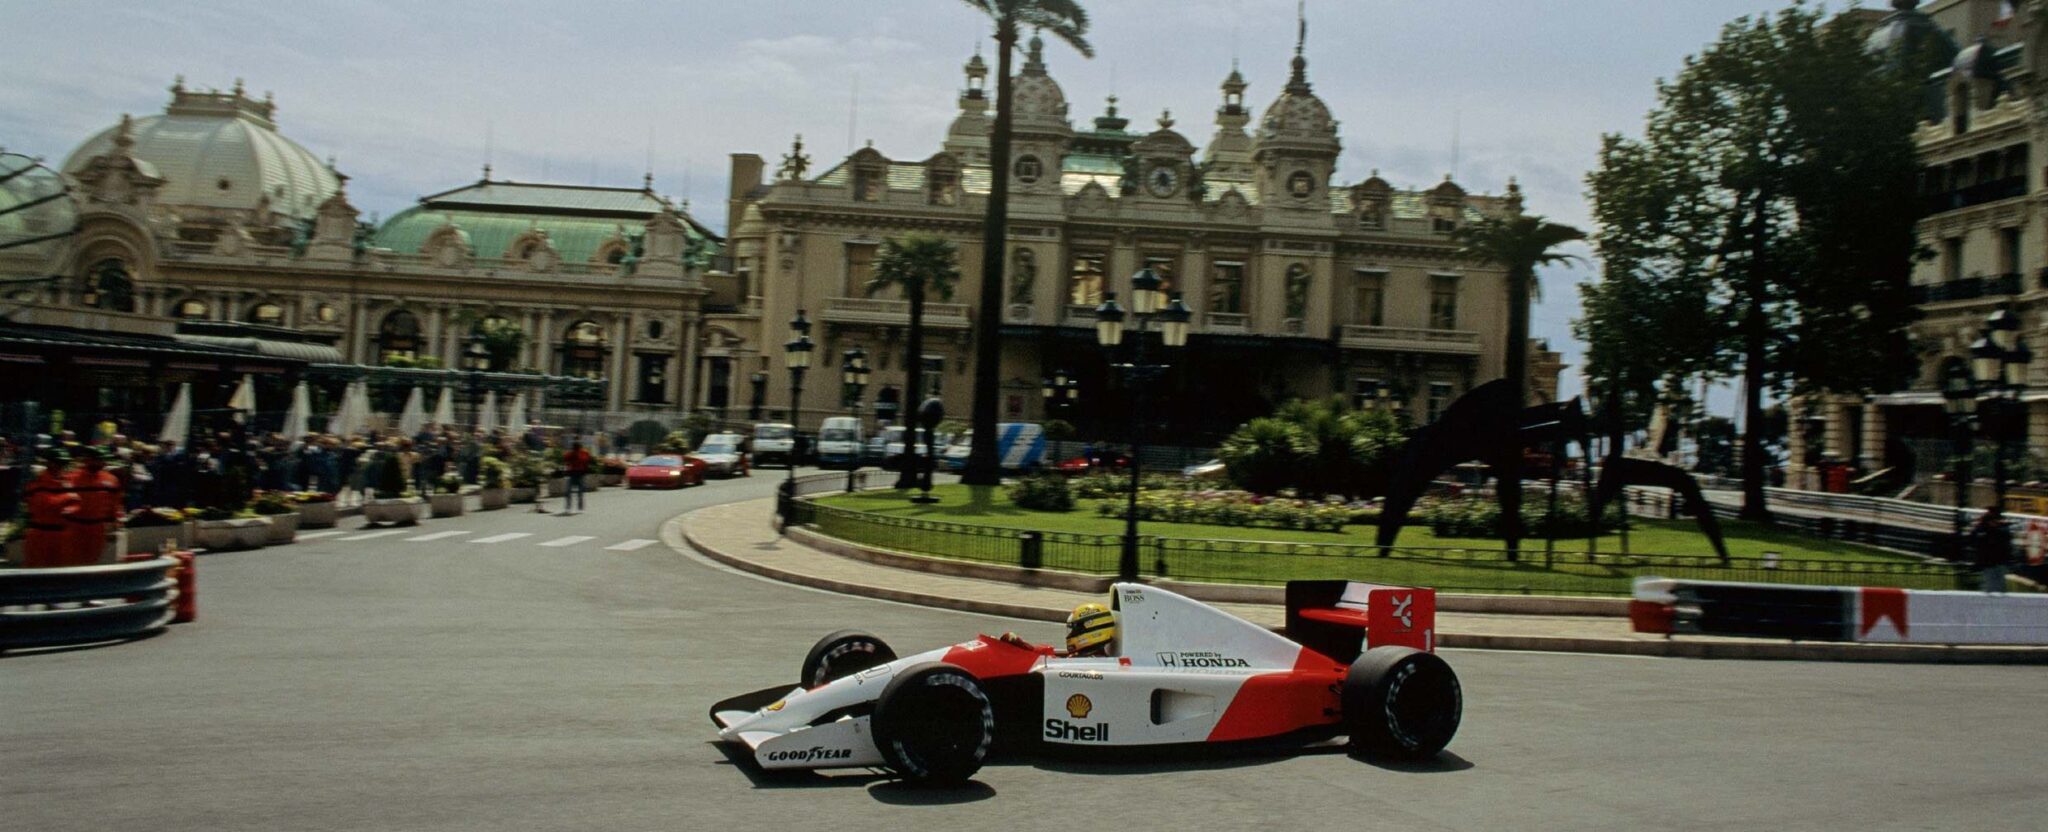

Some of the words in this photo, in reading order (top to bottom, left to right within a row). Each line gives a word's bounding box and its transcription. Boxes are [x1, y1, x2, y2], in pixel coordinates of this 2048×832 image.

[1181, 658, 1251, 667] HONDA
[1045, 718, 1109, 742] Shell
[768, 746, 852, 762] GOODYEAR
